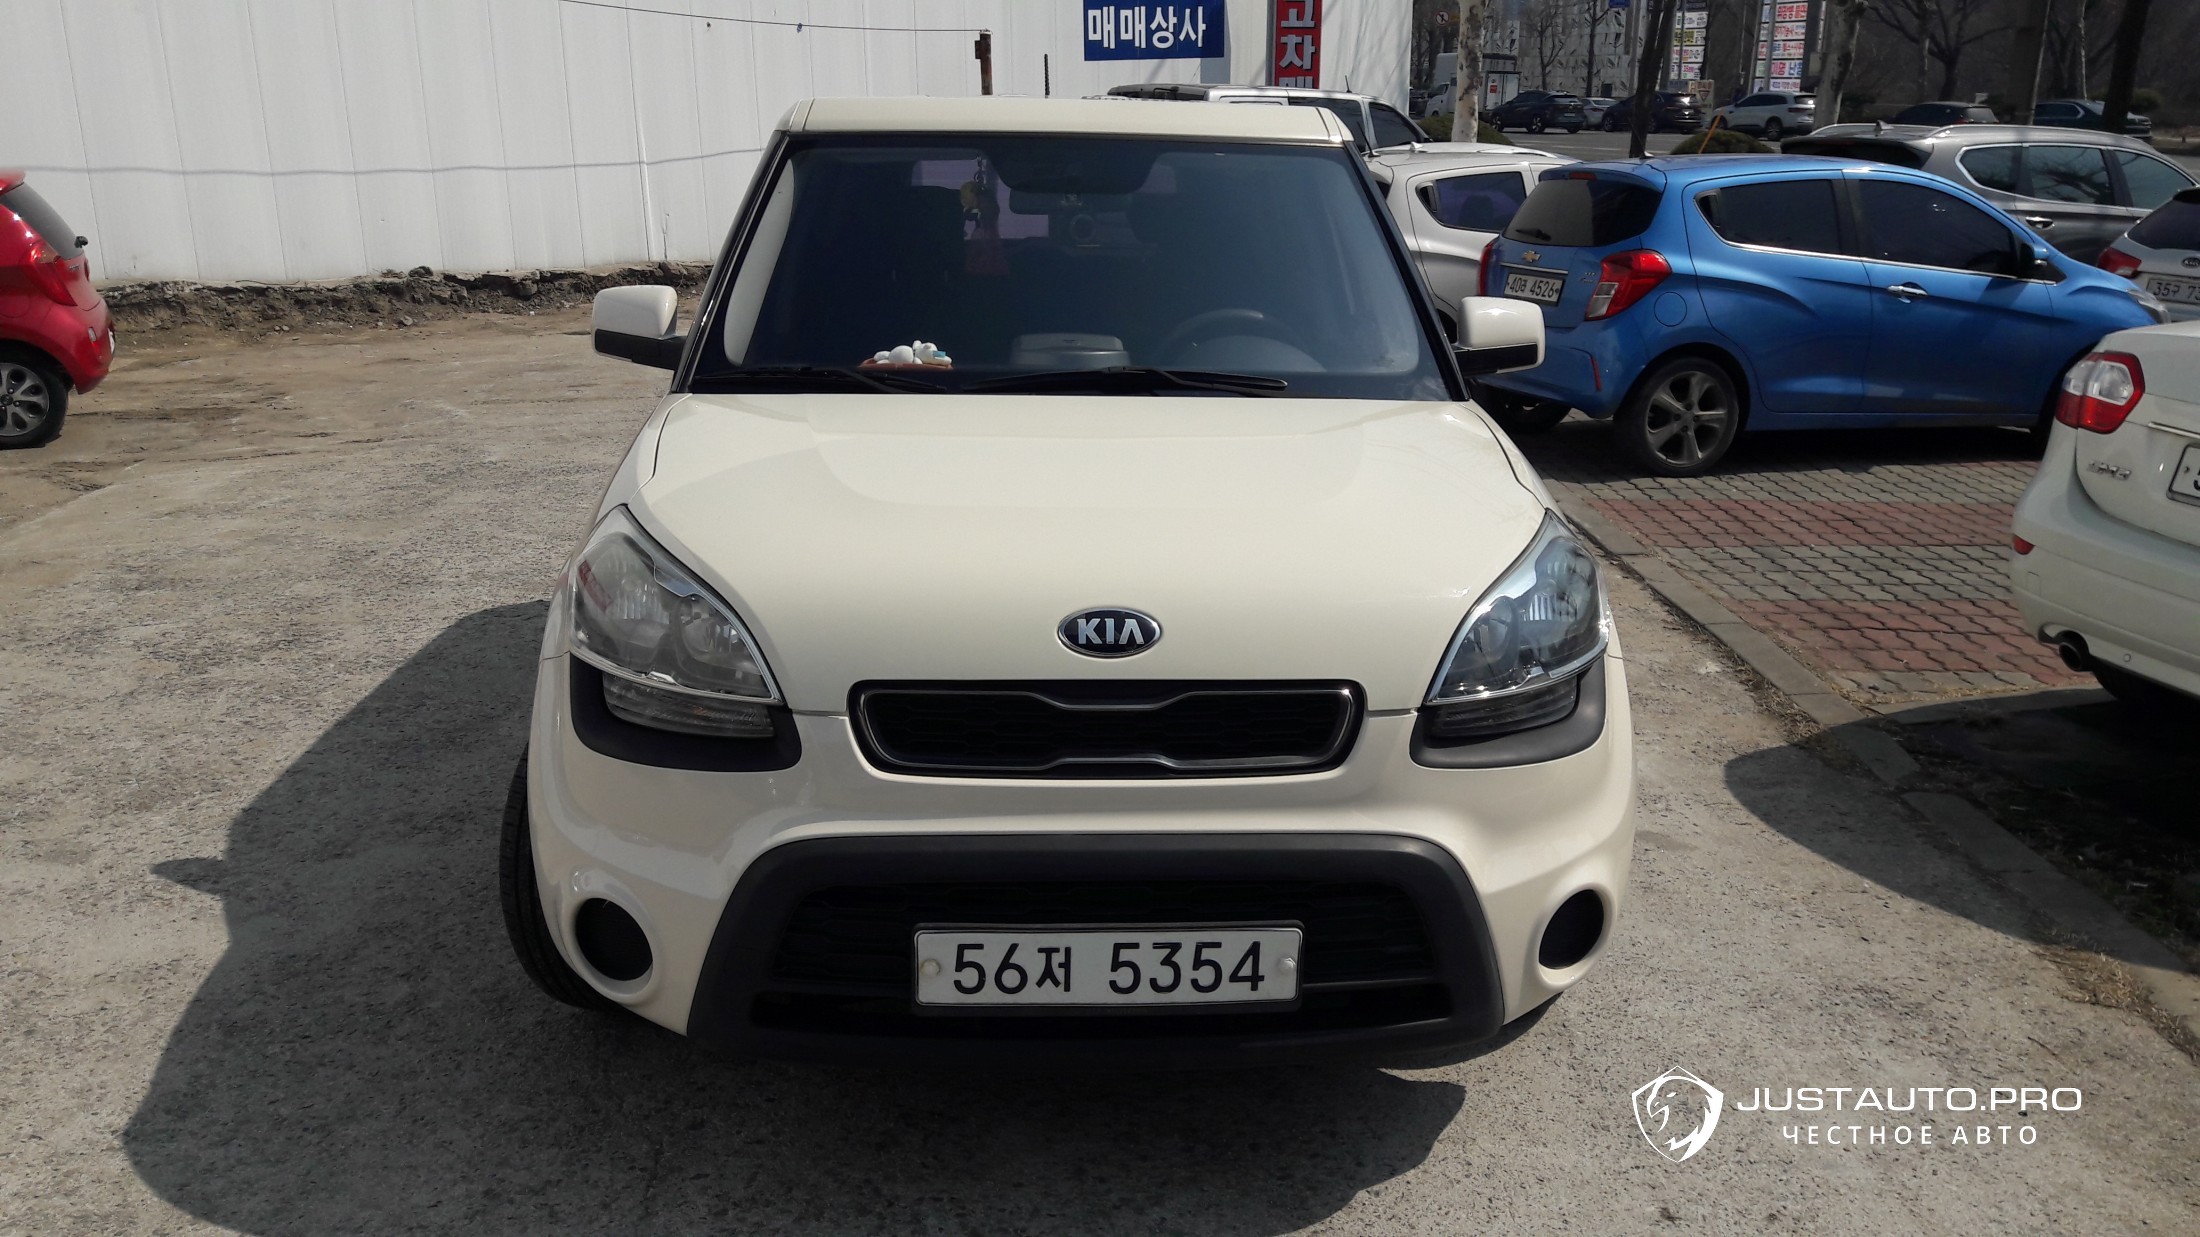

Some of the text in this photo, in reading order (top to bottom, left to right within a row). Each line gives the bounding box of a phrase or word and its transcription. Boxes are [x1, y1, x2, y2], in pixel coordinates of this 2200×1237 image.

[1088, 5, 1207, 49] 매매상사
[1529, 279, 1555, 298] 4526
[1077, 618, 1145, 645] KIA
[953, 941, 1265, 995] 56저 5354
